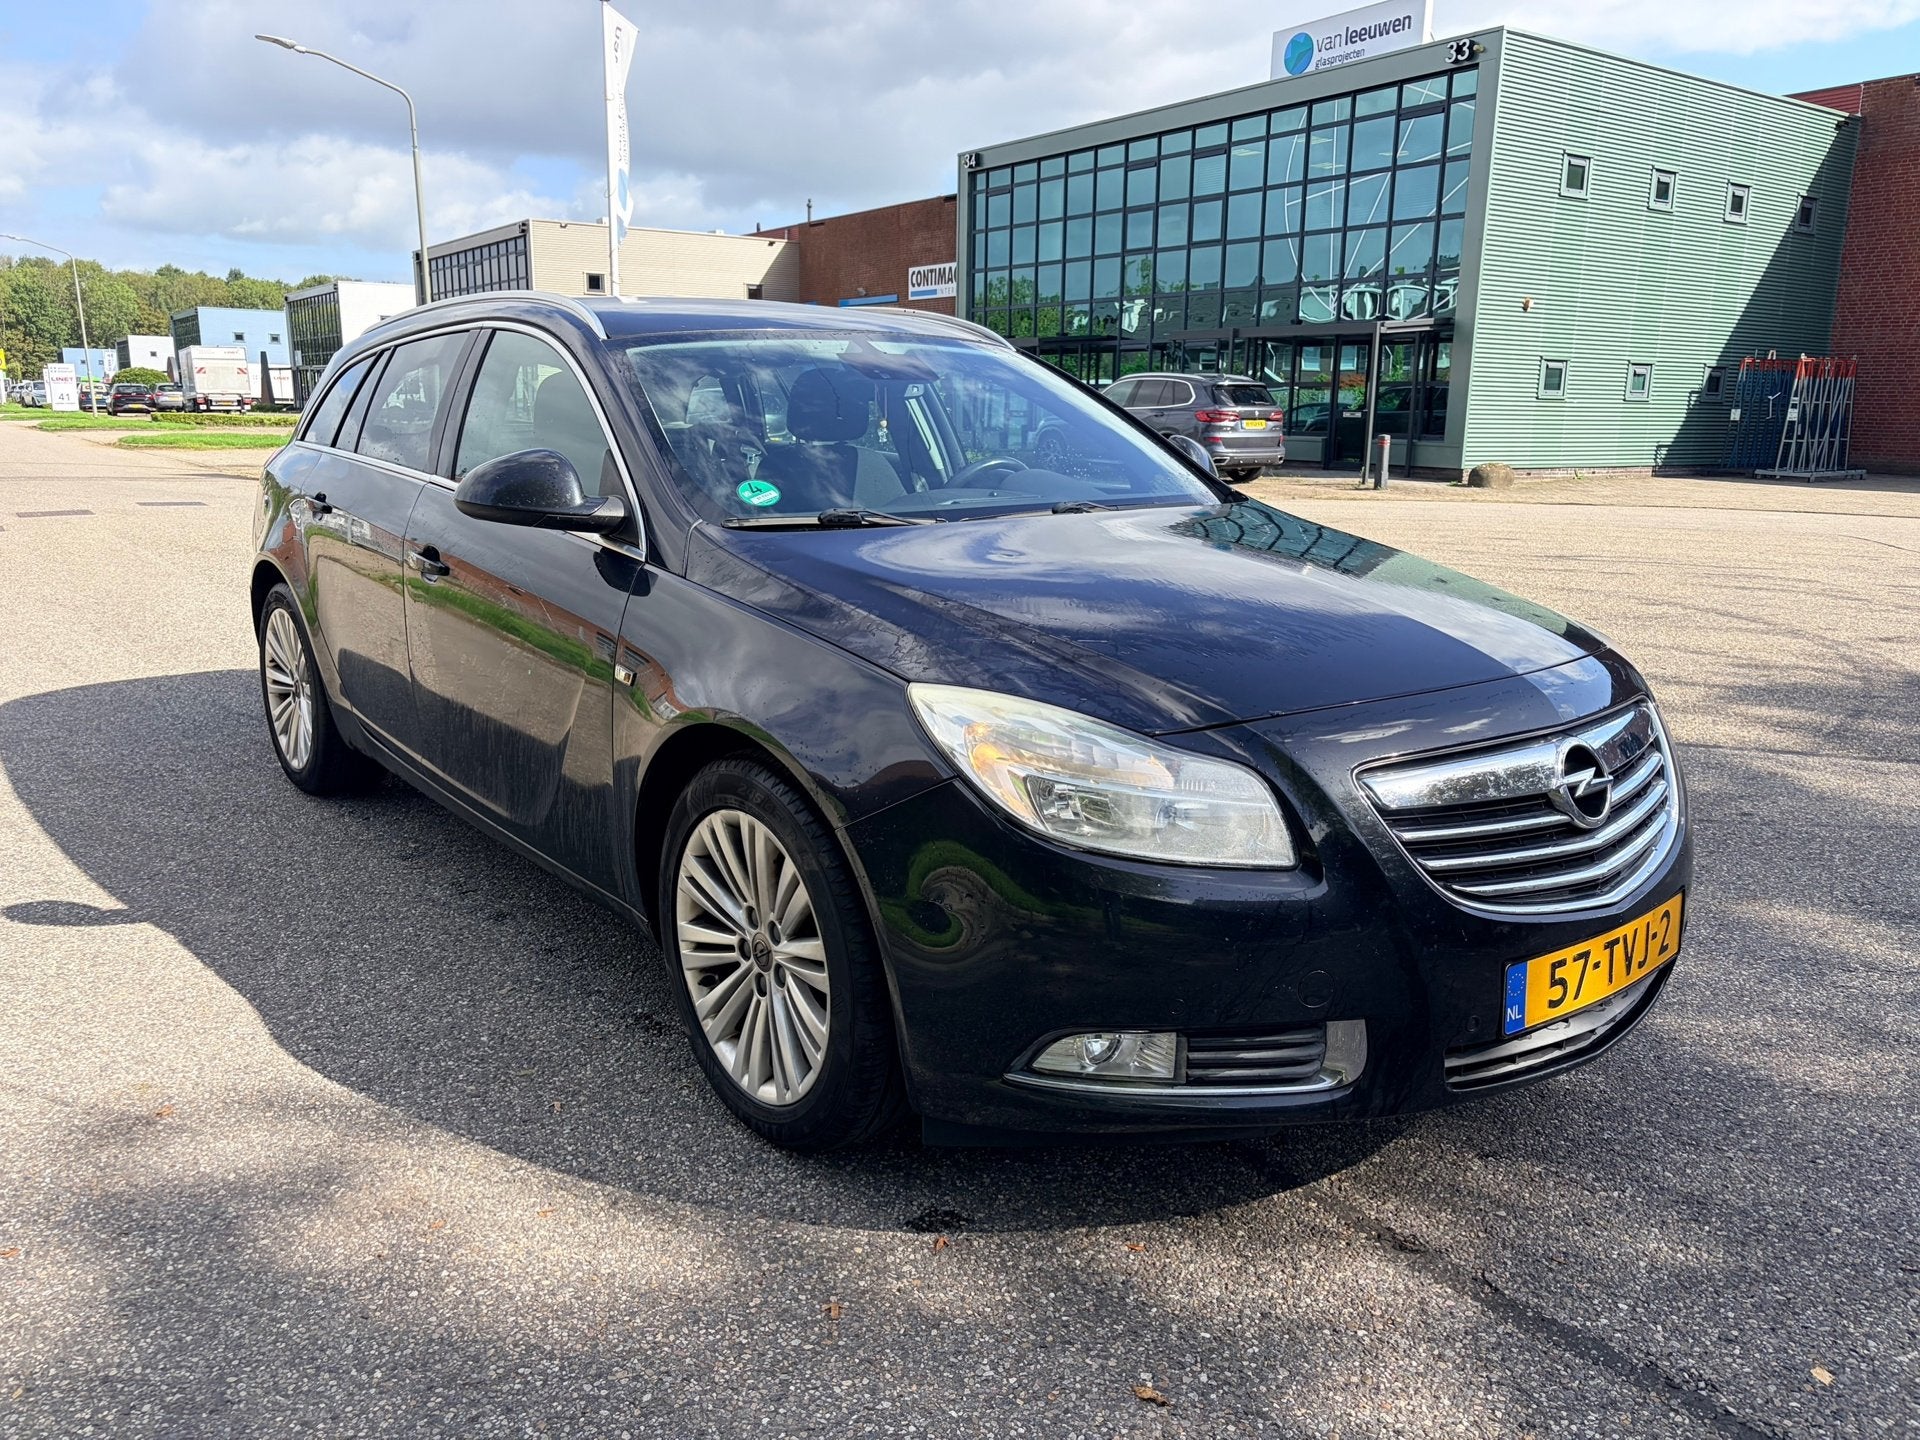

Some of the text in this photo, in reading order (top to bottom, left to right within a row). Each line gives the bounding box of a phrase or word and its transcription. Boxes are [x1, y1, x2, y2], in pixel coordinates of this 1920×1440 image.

[1316, 14, 1412, 53] van leeuwen
[1314, 48, 1365, 70] glasprojecten
[1445, 38, 1470, 63] 33
[963, 153, 976, 168] 34
[58, 393, 70, 401] 41
[747, 482, 763, 494] 4
[1547, 909, 1671, 1009] 57-TVJ-2
[1506, 1005, 1522, 1022] NL
